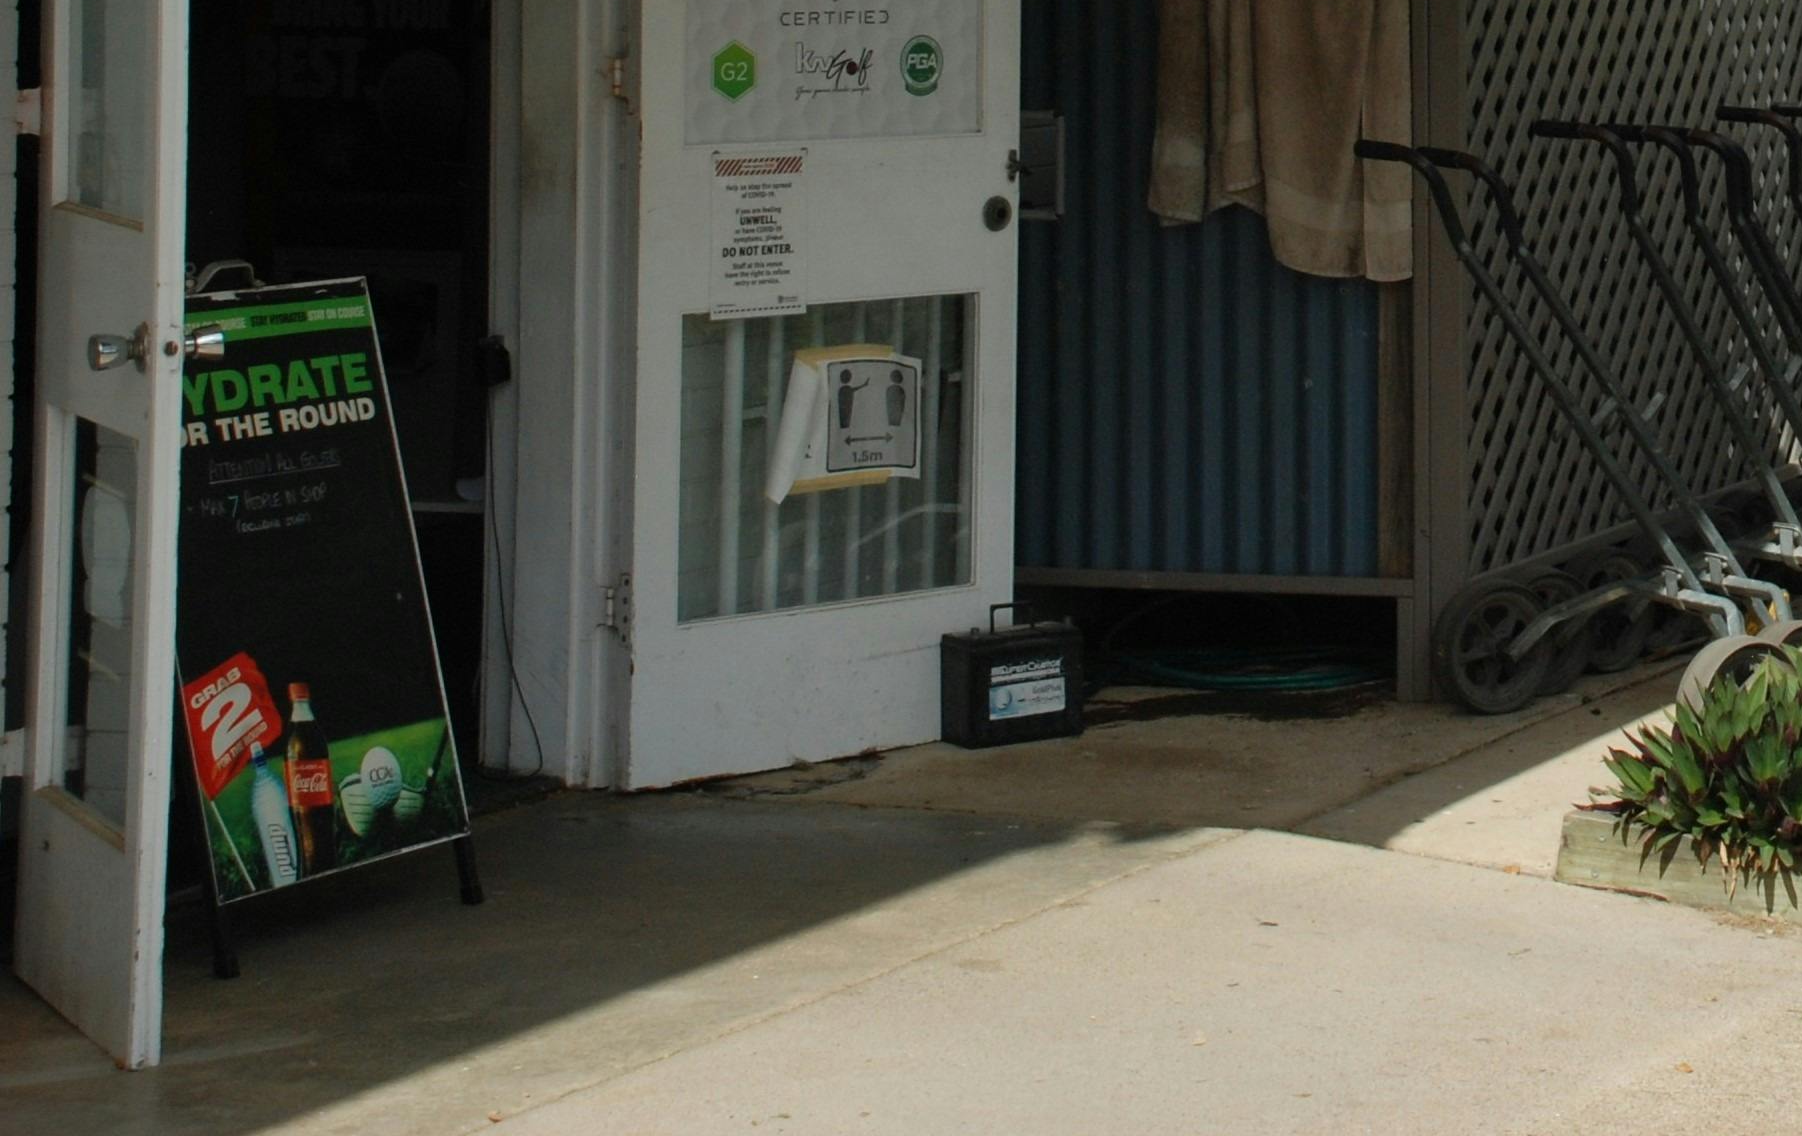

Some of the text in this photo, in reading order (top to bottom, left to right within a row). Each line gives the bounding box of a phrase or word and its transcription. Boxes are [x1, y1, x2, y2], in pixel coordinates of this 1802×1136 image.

[719, 62, 748, 82] G2
[907, 53, 937, 71] PGA
[722, 243, 794, 258] DO NOT ENTER.
[215, 411, 273, 442] THE
[279, 397, 376, 433] ROUND
[852, 450, 883, 464] 1.5m
[227, 495, 240, 519] 7
[190, 667, 242, 710] GRAB
[201, 681, 264, 762] 2
